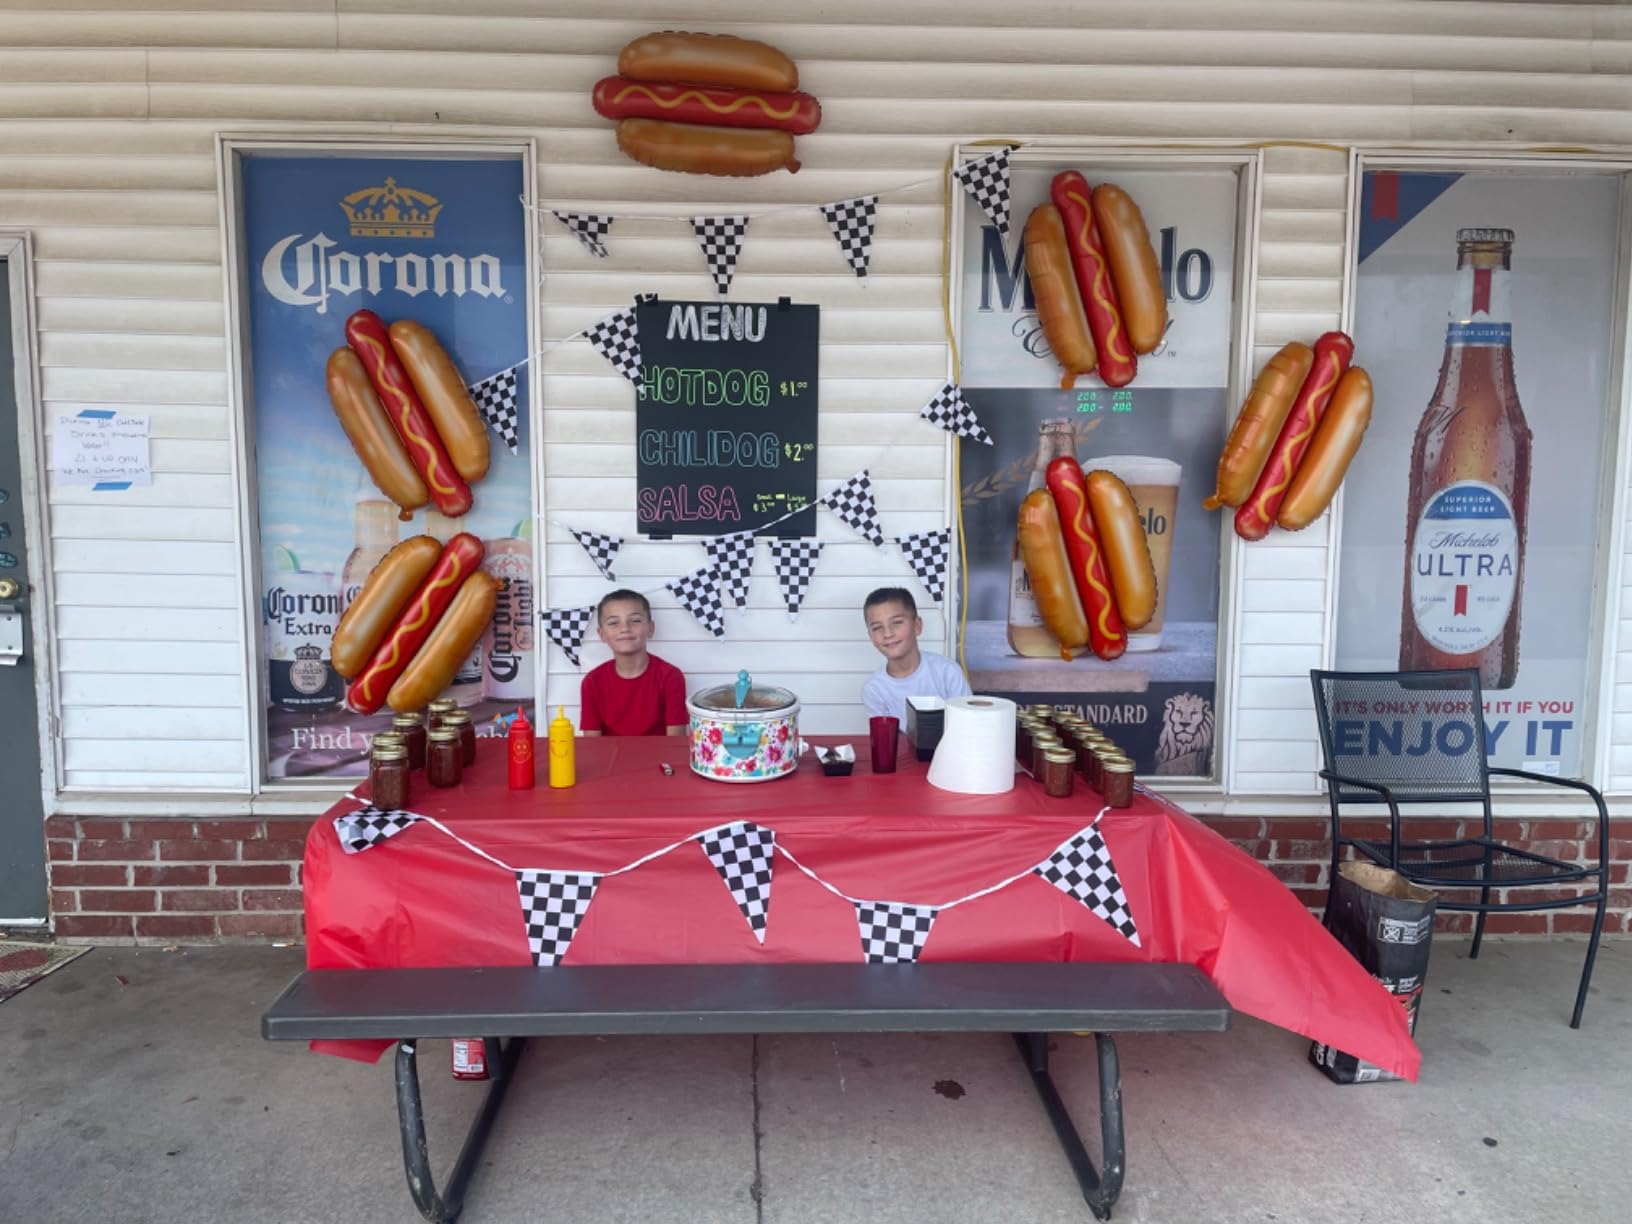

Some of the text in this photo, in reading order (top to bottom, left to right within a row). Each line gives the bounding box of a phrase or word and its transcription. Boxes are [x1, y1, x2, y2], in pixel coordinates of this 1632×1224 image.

[262, 232, 507, 313] Corona
[978, 224, 1214, 313] Mlo
[666, 304, 768, 342] MENU
[640, 364, 771, 407] HOTDOG
[639, 428, 780, 469] CHILIDOG
[638, 484, 742, 522] SALSA
[1440, 505, 1467, 513] LIGHT
[1444, 495, 1491, 503] SUPERIOR
[1429, 530, 1502, 549] Michelob
[1417, 553, 1513, 577] ULTRA
[268, 587, 343, 623] Coron
[285, 617, 332, 636] Extra
[1334, 701, 1574, 714] IT'S ONLY WORH IT IF YOU
[291, 725, 353, 750] Find
[1335, 720, 1574, 757] ENJOY IT
